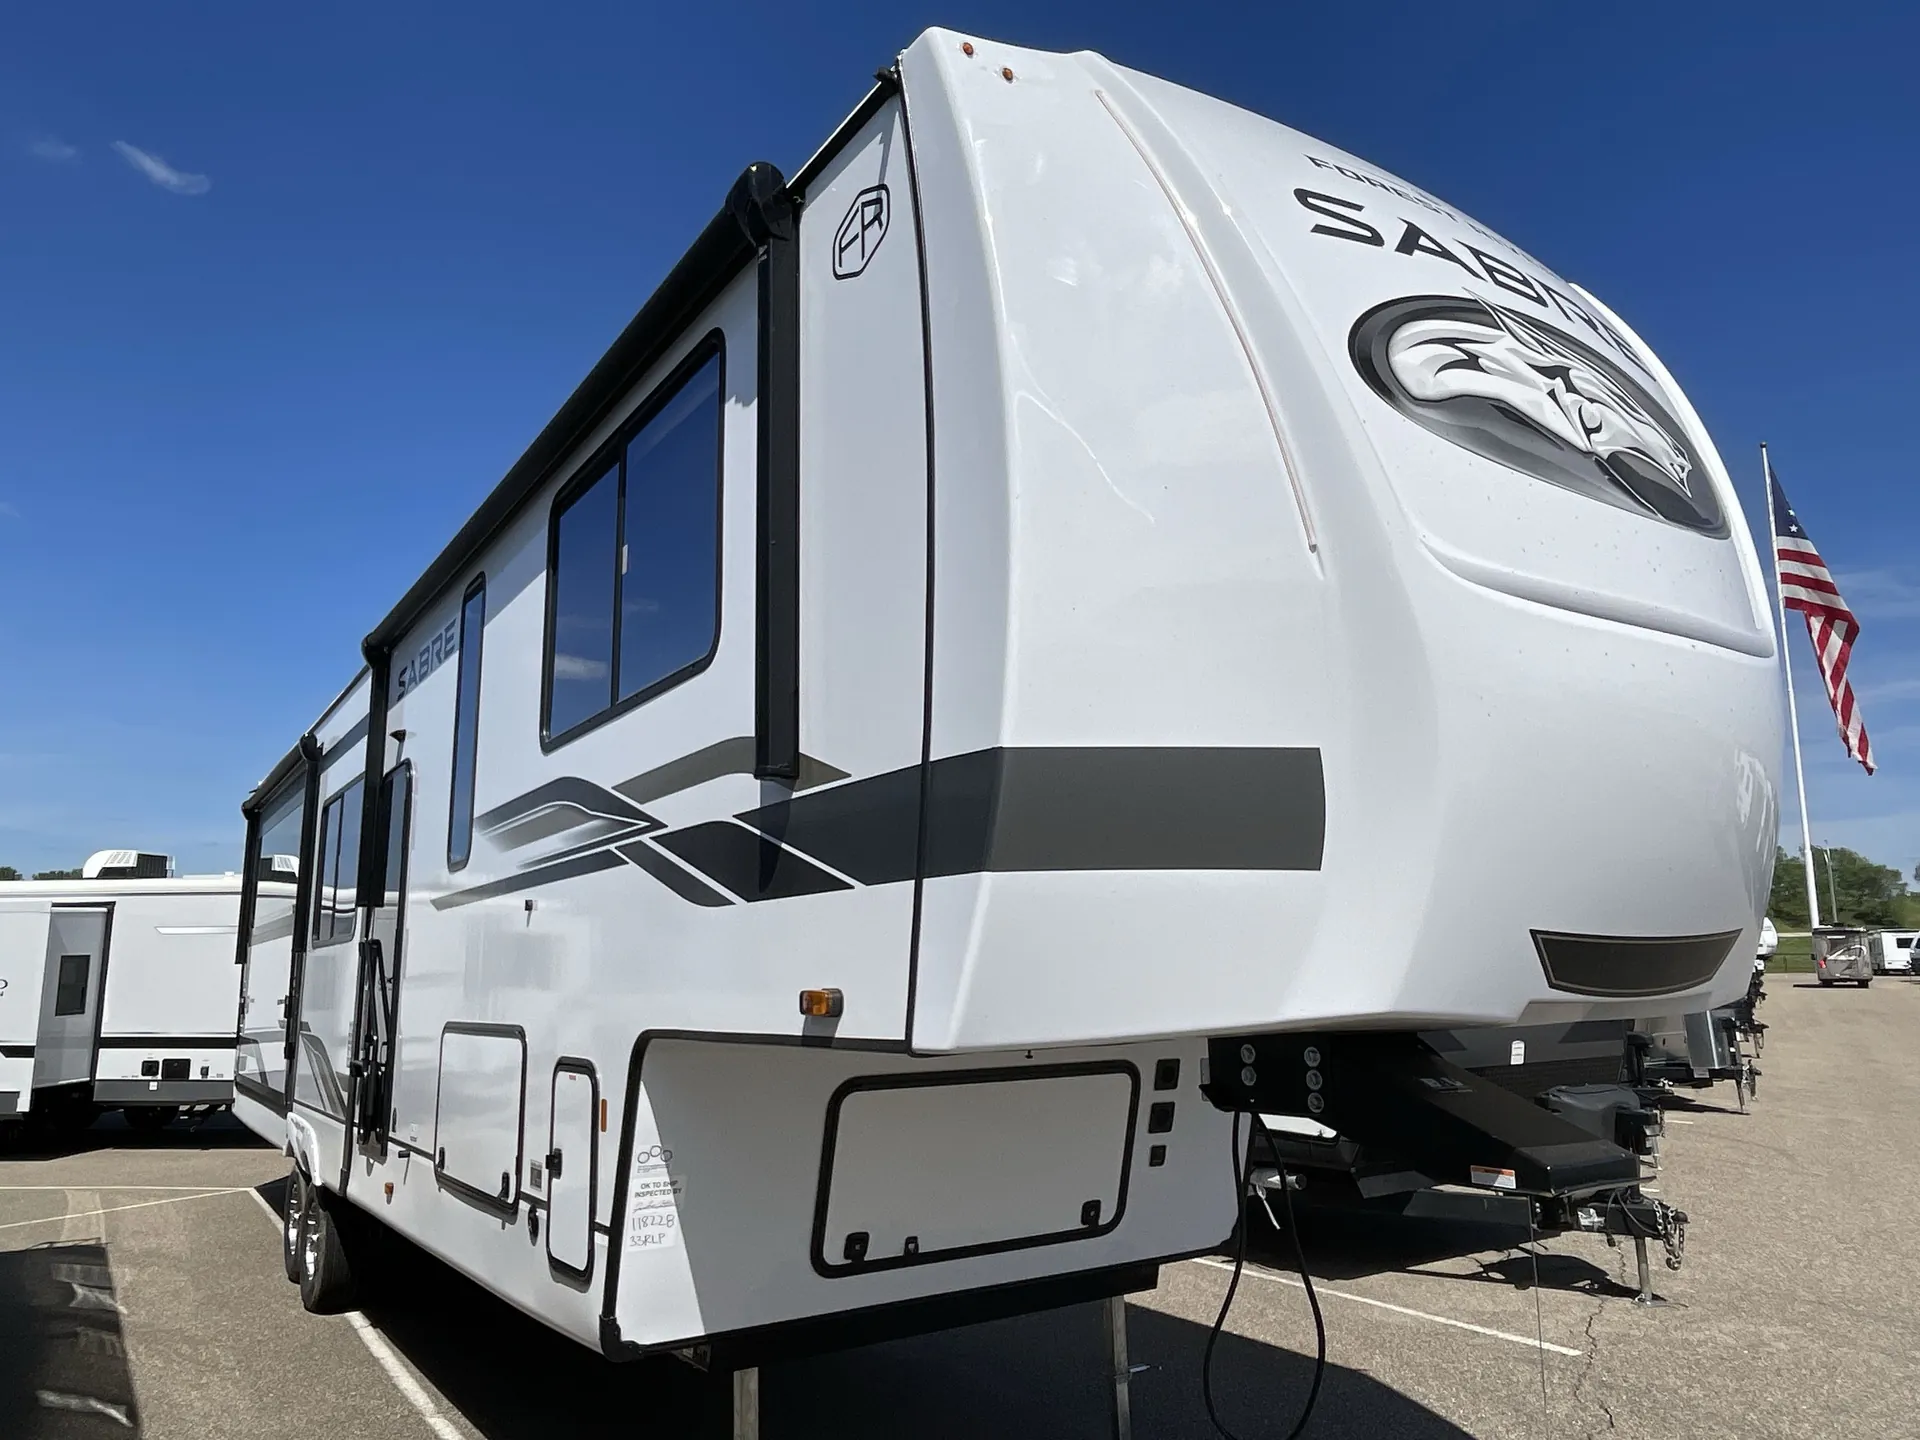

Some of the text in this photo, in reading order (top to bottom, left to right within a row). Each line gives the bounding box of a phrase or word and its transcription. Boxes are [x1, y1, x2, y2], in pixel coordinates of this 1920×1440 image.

[1293, 187, 1657, 383] SABRE
[397, 617, 457, 702] SABRE
[634, 1189, 672, 1198] INSPECTED
[640, 1182, 651, 1190] OK
